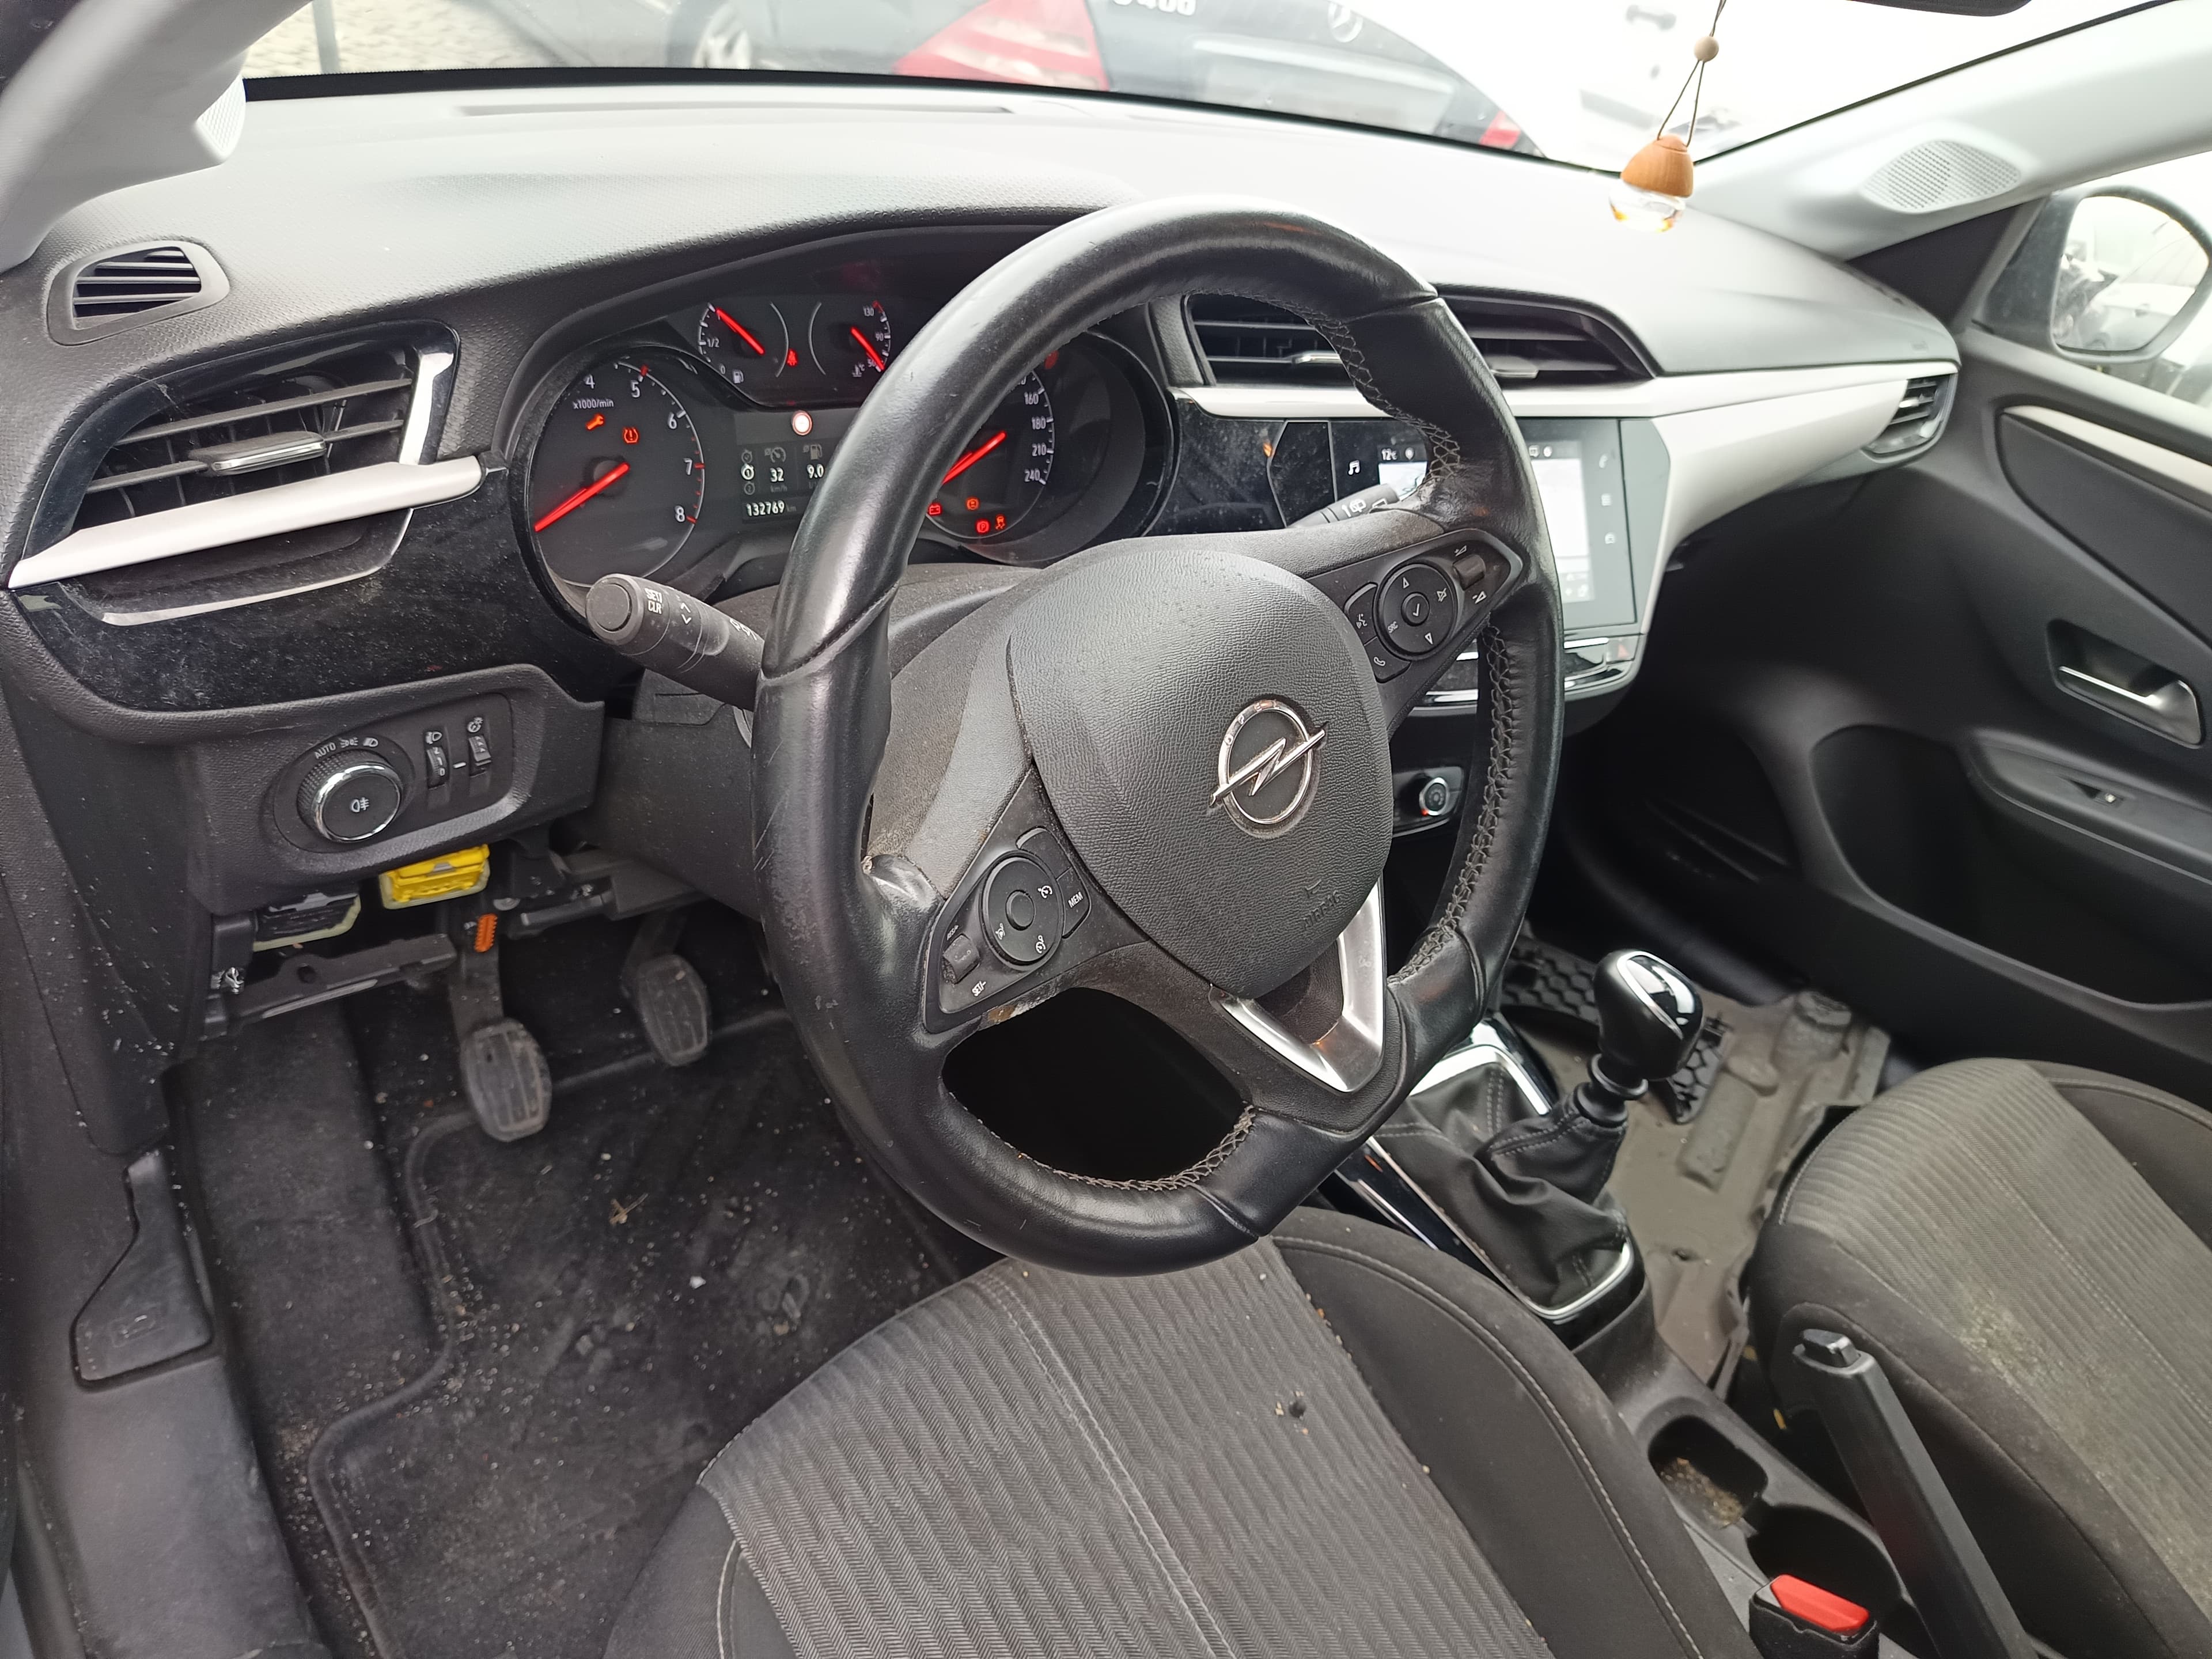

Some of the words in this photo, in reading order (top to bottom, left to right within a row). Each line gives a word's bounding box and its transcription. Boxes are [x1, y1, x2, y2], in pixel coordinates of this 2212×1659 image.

[863, 306, 874, 316] 130
[707, 338, 719, 348] 1/2
[876, 332, 884, 342] 90
[584, 374, 595, 389] 4
[631, 380, 641, 398] 5
[573, 398, 614, 410] x1000/min
[1024, 392, 1039, 405] 160
[668, 412, 677, 430] 6
[1032, 416, 1046, 430] 180
[1032, 442, 1047, 456] 210
[683, 458, 692, 475] 7
[806, 464, 824, 479] 9.0
[770, 467, 784, 482] 32
[1024, 468, 1041, 482] 240
[675, 505, 685, 522] 8
[746, 500, 785, 517] 132769
[648, 600, 662, 615] CLR
[314, 742, 336, 759] AUTO
[1068, 891, 1084, 908] MEM
